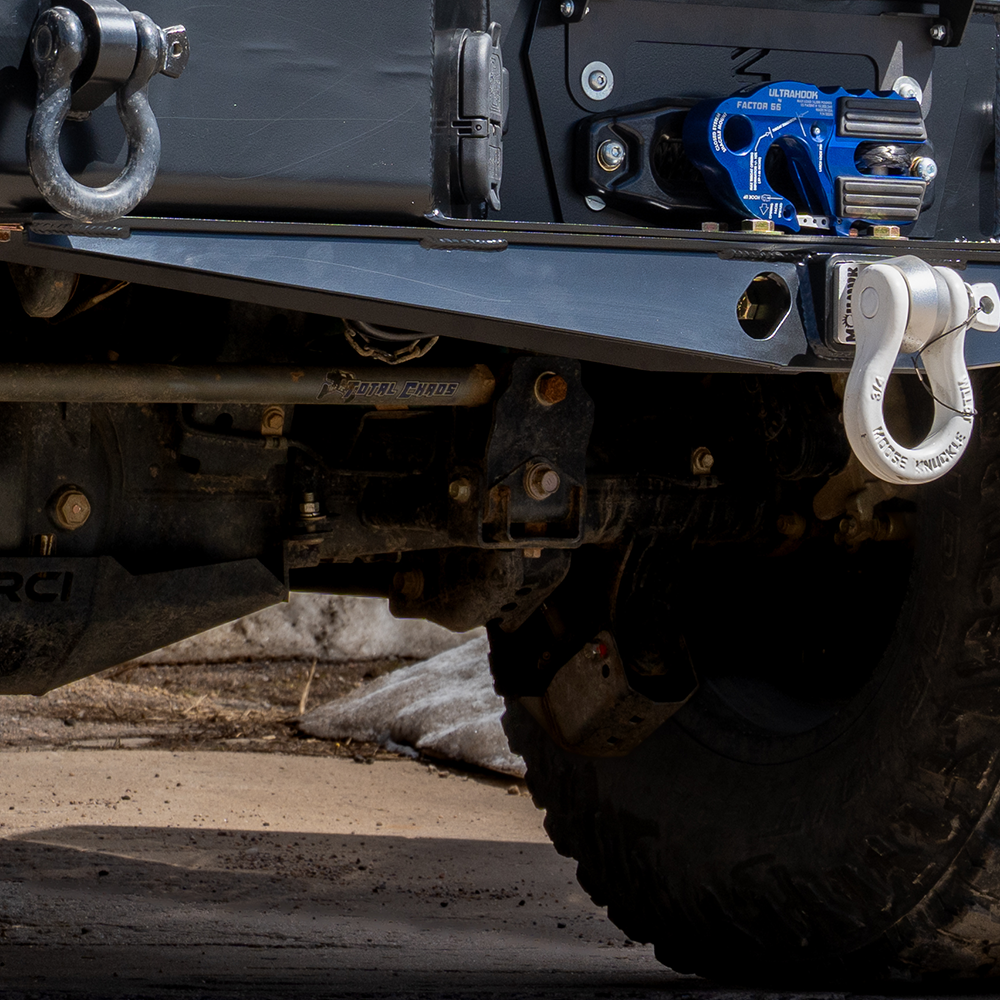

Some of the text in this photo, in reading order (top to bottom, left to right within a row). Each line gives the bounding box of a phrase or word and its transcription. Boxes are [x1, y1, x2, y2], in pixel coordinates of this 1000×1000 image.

[768, 88, 819, 100] ULTRAHOOK
[736, 101, 768, 111] FACTOR
[343, 379, 460, 400] TOTAL CHAOS
[872, 425, 967, 474] MOOSE KNUCKLE
[0, 571, 74, 601] RCI
